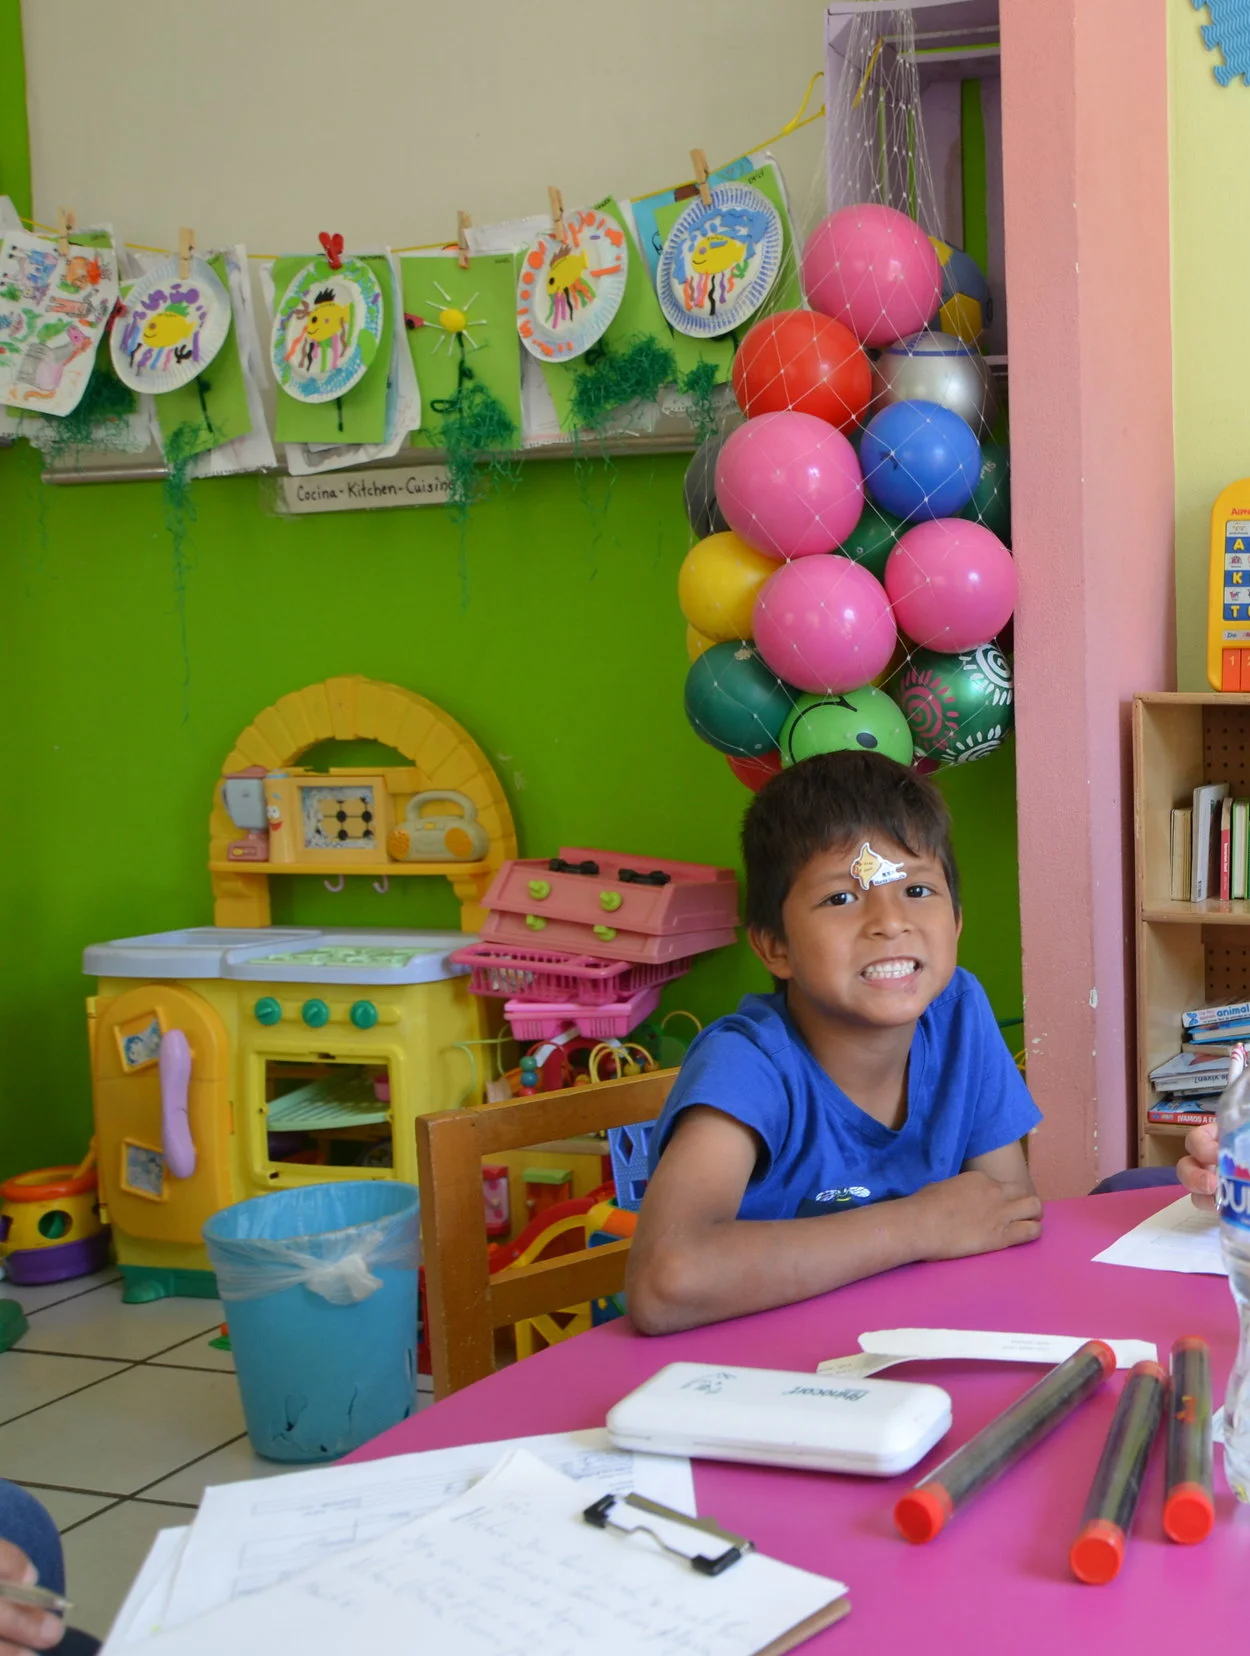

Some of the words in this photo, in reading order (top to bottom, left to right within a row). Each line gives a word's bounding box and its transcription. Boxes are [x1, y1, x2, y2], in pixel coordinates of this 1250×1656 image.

[1233, 538, 1245, 550] A
[1232, 572, 1243, 584] K
[1230, 605, 1240, 618] T
[1230, 656, 1235, 666] 1
[1216, 1003, 1250, 1017] animal
[788, 1385, 871, 1402] Rhinocort
